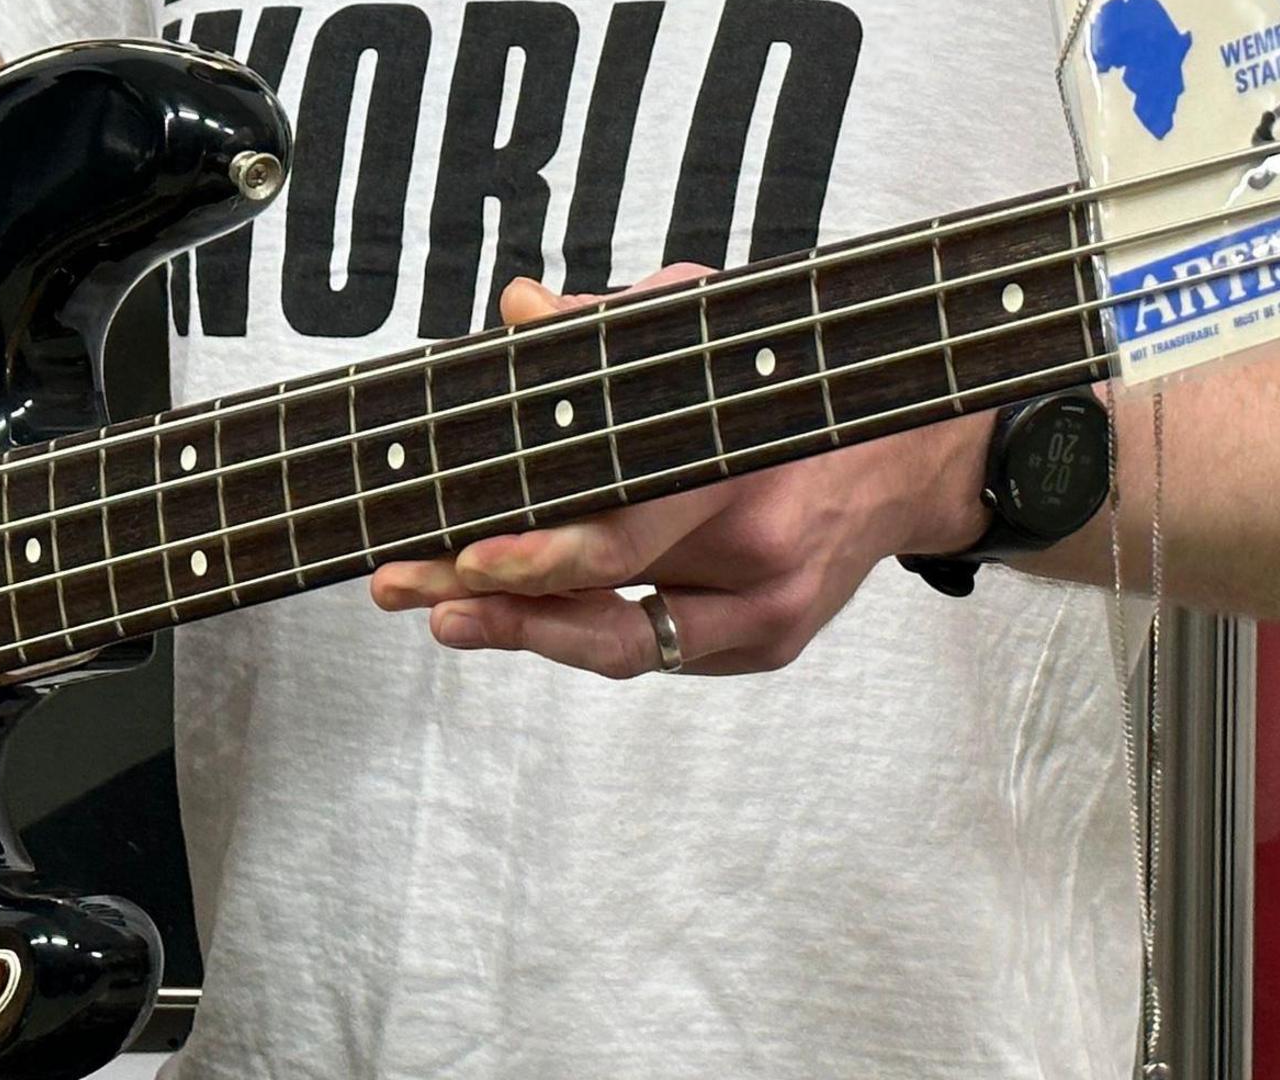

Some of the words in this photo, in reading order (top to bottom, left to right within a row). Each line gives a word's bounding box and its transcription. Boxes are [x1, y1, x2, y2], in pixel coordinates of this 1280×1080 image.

[1130, 349, 1148, 362] NOT
[1152, 323, 1220, 354] TRANSFERABLE
[1233, 309, 1259, 328] MUST
